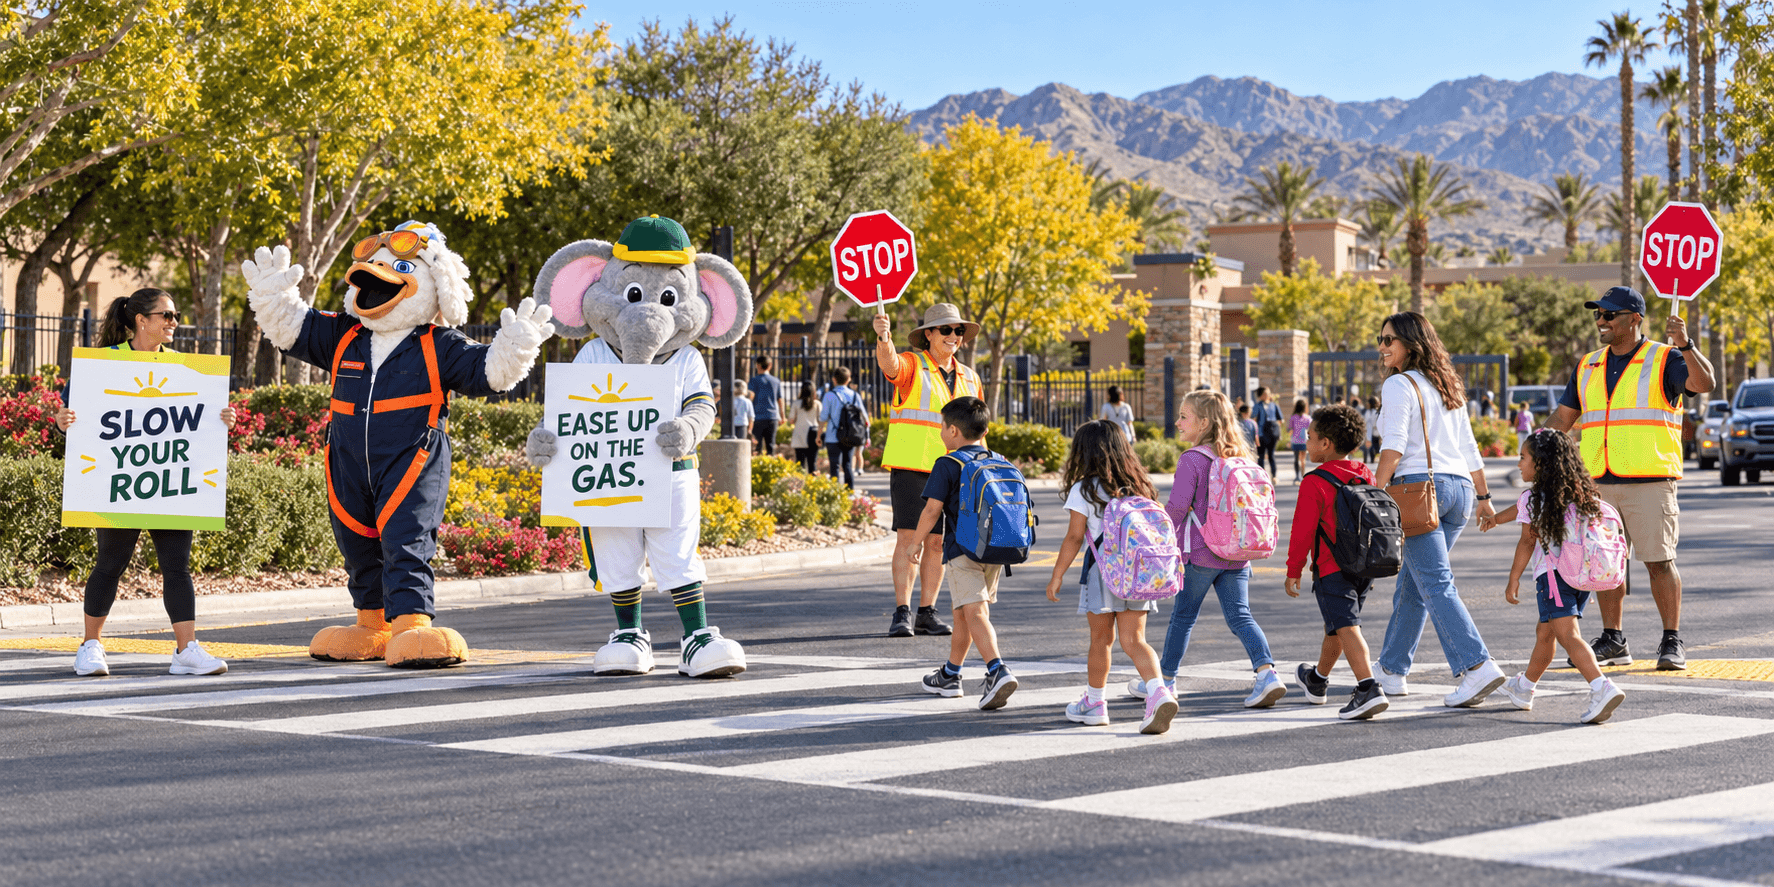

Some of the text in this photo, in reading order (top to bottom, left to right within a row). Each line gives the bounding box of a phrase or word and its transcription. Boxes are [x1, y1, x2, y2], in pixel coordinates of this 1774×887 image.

[840, 238, 910, 282] STOP
[1646, 231, 1715, 271] STOP
[98, 403, 205, 441] SLOW
[557, 408, 660, 437] EASE UP
[110, 438, 190, 470] YOUR
[570, 438, 645, 461] ON THE
[109, 466, 198, 503] ROLL
[571, 461, 645, 494] GAS.
